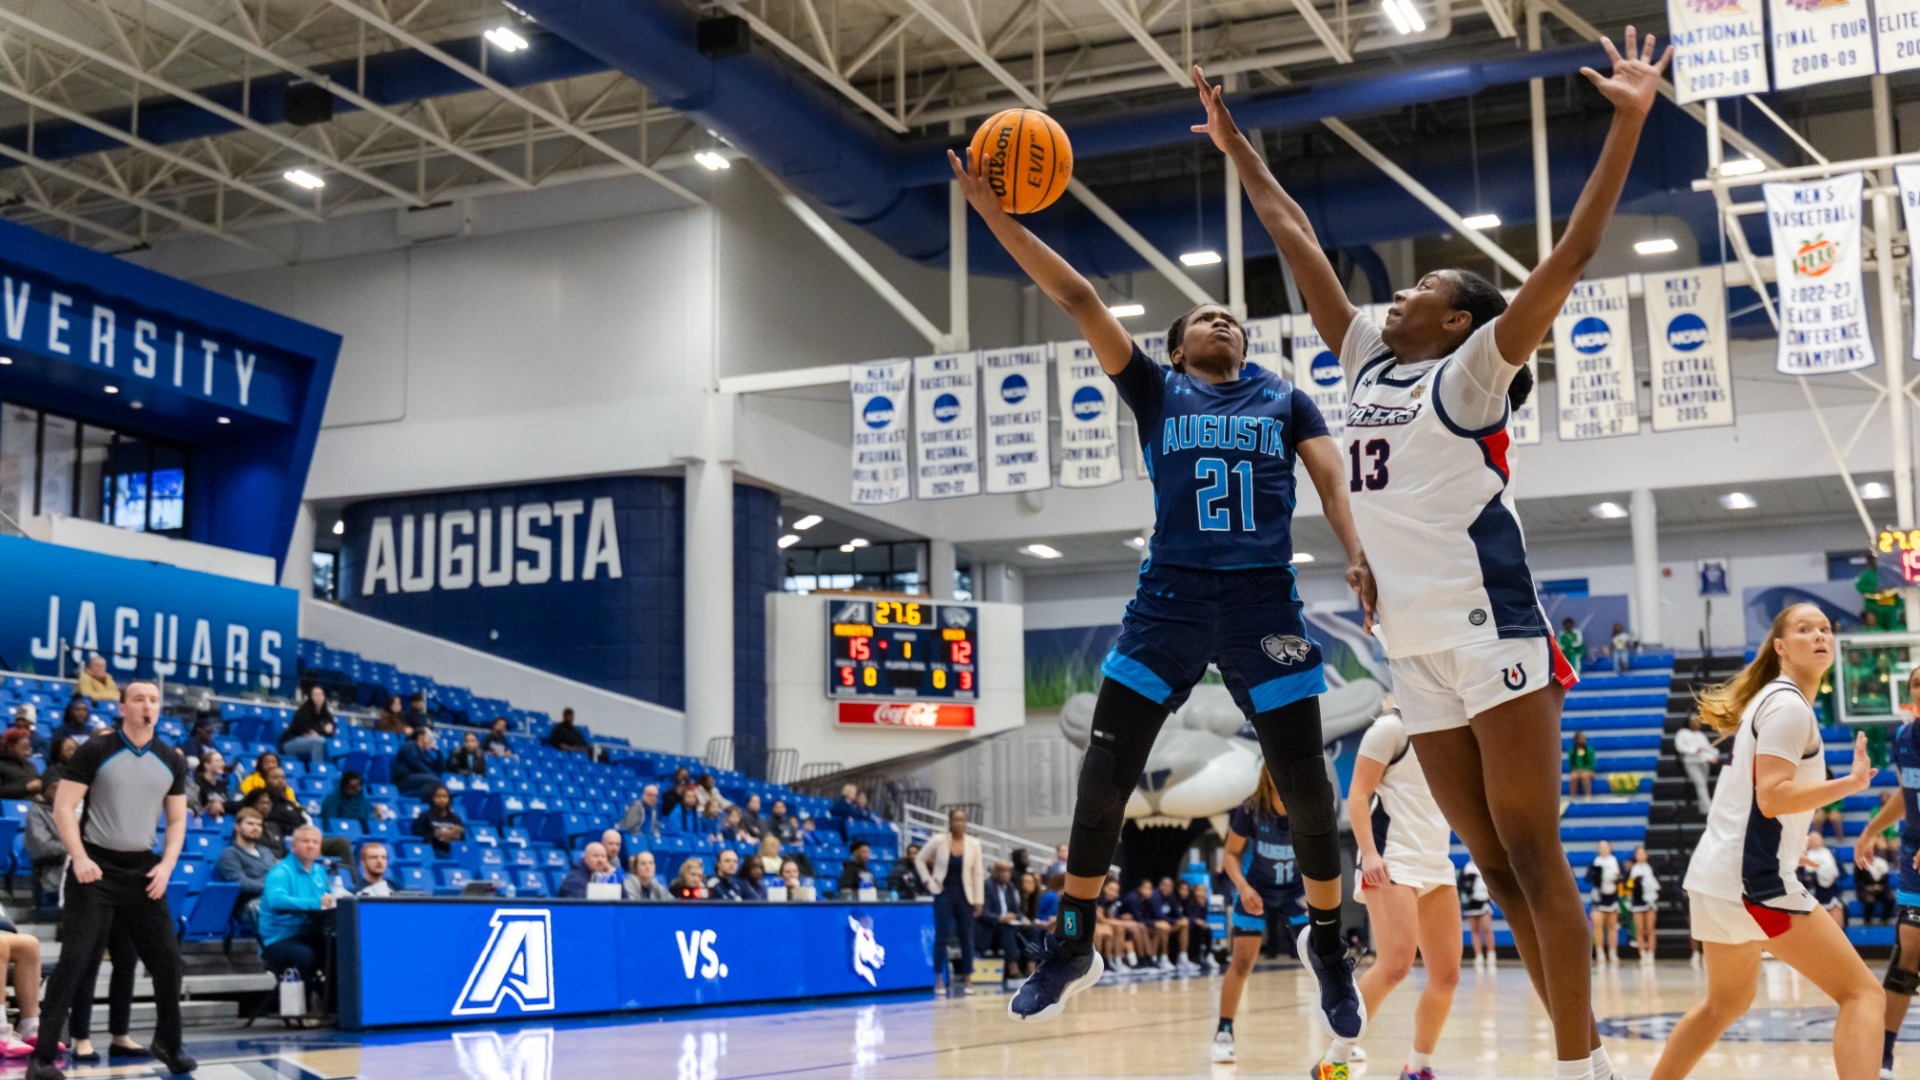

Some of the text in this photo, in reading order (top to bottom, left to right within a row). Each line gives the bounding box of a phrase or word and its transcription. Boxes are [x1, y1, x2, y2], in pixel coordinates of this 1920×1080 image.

[1879, 11, 1919, 33] ELITE
[1671, 21, 1761, 46] NATIONAL
[1776, 18, 1866, 49] FINAL FOUR
[1676, 43, 1760, 72] FINALIST
[1792, 49, 1857, 75] 2008-09
[1690, 68, 1750, 92] 2007-08
[1774, 204, 1856, 227] BASKETBALL
[1664, 277, 1701, 294] MEN'S
[1791, 282, 1850, 302] 2022-23
[1563, 298, 1626, 315] ASKETBALL
[1668, 293, 1698, 309] GOLF
[4, 276, 256, 406] VERSITY
[1786, 322, 1863, 346] CONFERENCE
[987, 352, 1041, 368] VOLLEYBALL
[1577, 357, 1611, 374] SOUTH
[1662, 357, 1716, 374] CENTRAL
[1787, 345, 1865, 369] CHAMPIONS
[921, 374, 972, 390] BASKETBALL
[1570, 372, 1622, 391] ATLANTIC
[1662, 373, 1720, 391] REGIONAL
[1570, 389, 1622, 406] REGIONAL
[1658, 389, 1725, 408] CHAMPIONS
[990, 410, 1041, 426] SOUTHEAST
[1677, 406, 1708, 423] 2005
[921, 427, 972, 443] SOUTHEAST
[996, 432, 1035, 446] REGIONAL
[1162, 414, 1284, 460] AUGUSTA
[926, 446, 968, 460] REGIONAL
[996, 451, 1038, 466] CHAMPIONS
[1349, 438, 1390, 493] 13
[1195, 457, 1256, 531] 21
[362, 497, 622, 595] AUGUSTA
[875, 601, 921, 626] 27.6
[31, 595, 282, 689] JAGUARS
[849, 637, 870, 660] 15
[903, 641, 912, 659] 1
[951, 640, 972, 664] 12
[841, 666, 854, 686] 5
[863, 667, 877, 687] 0
[932, 669, 946, 689] 0
[959, 670, 972, 690] 3
[1273, 861, 1294, 885] 11
[675, 930, 728, 979] VS.
